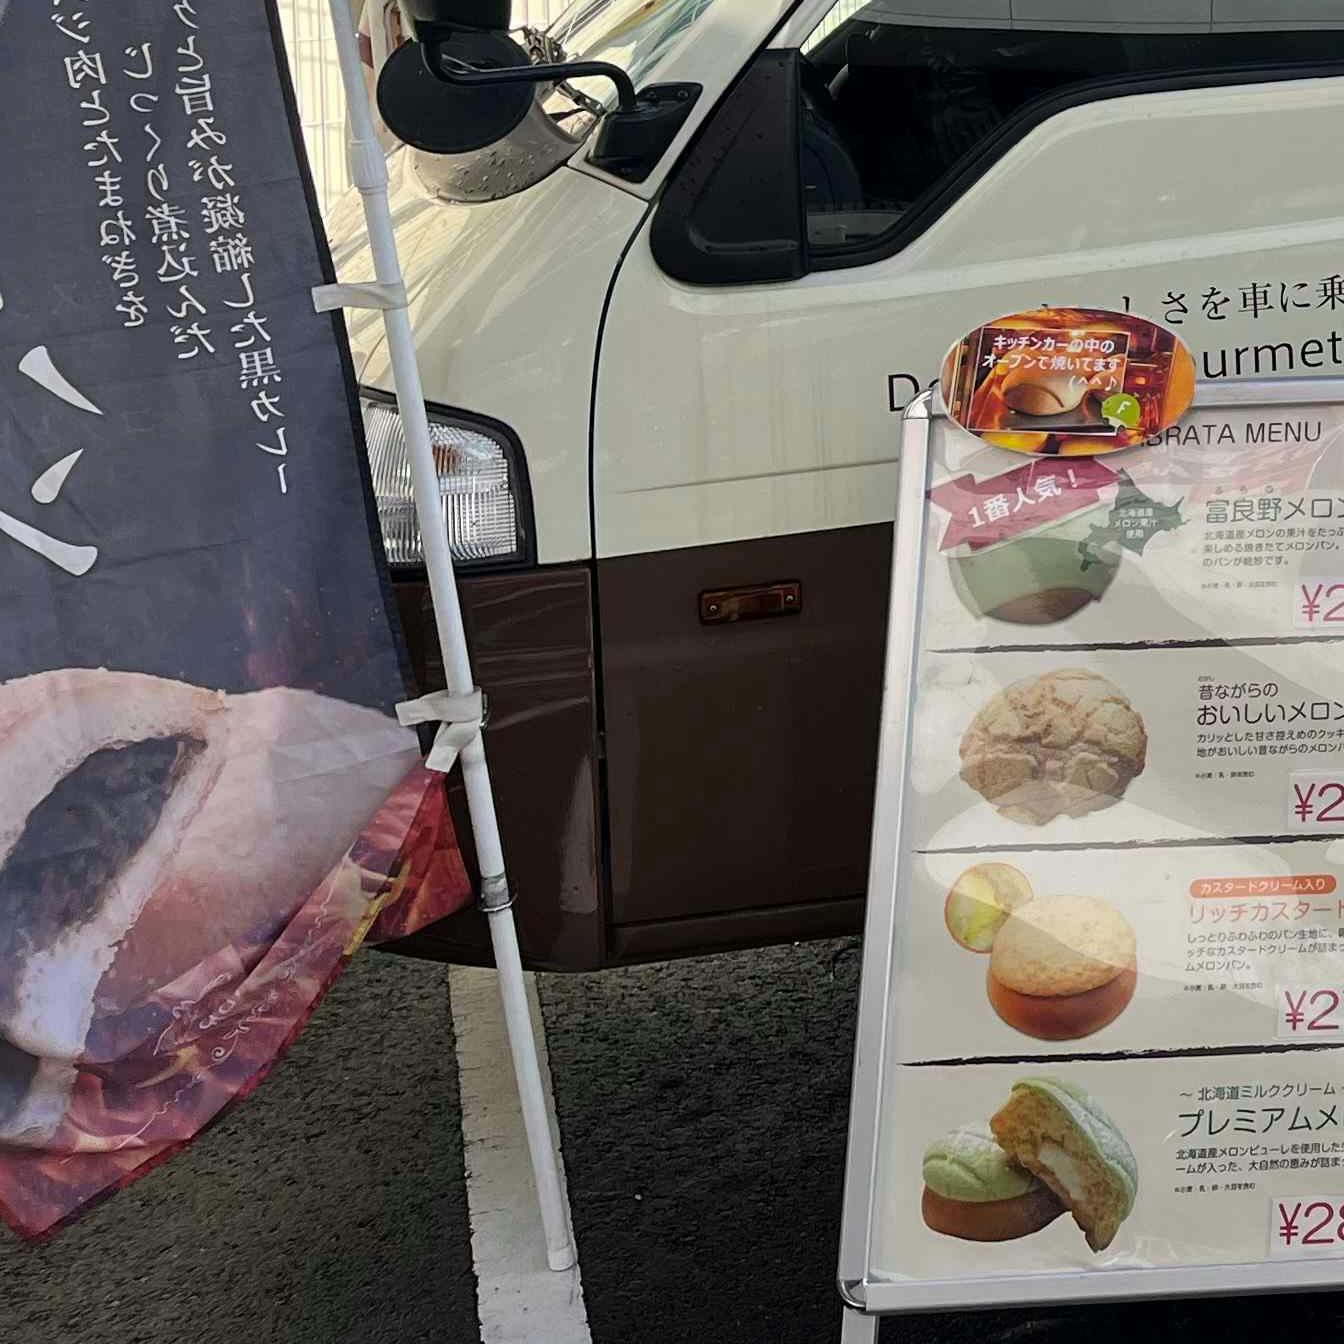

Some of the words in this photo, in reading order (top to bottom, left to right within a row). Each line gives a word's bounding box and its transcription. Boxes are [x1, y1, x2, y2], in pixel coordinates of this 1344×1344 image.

[993, 335, 1116, 354] キッチンカーの中の
[1202, 324, 1342, 380] urmet
[981, 354, 1121, 372] オープンで焼いてます
[1141, 423, 1233, 449] BRATA
[1245, 421, 1322, 444] MENU
[1198, 681, 1279, 701] 昔ながらの
[1199, 878, 1327, 896] カスタードクリーム入り
